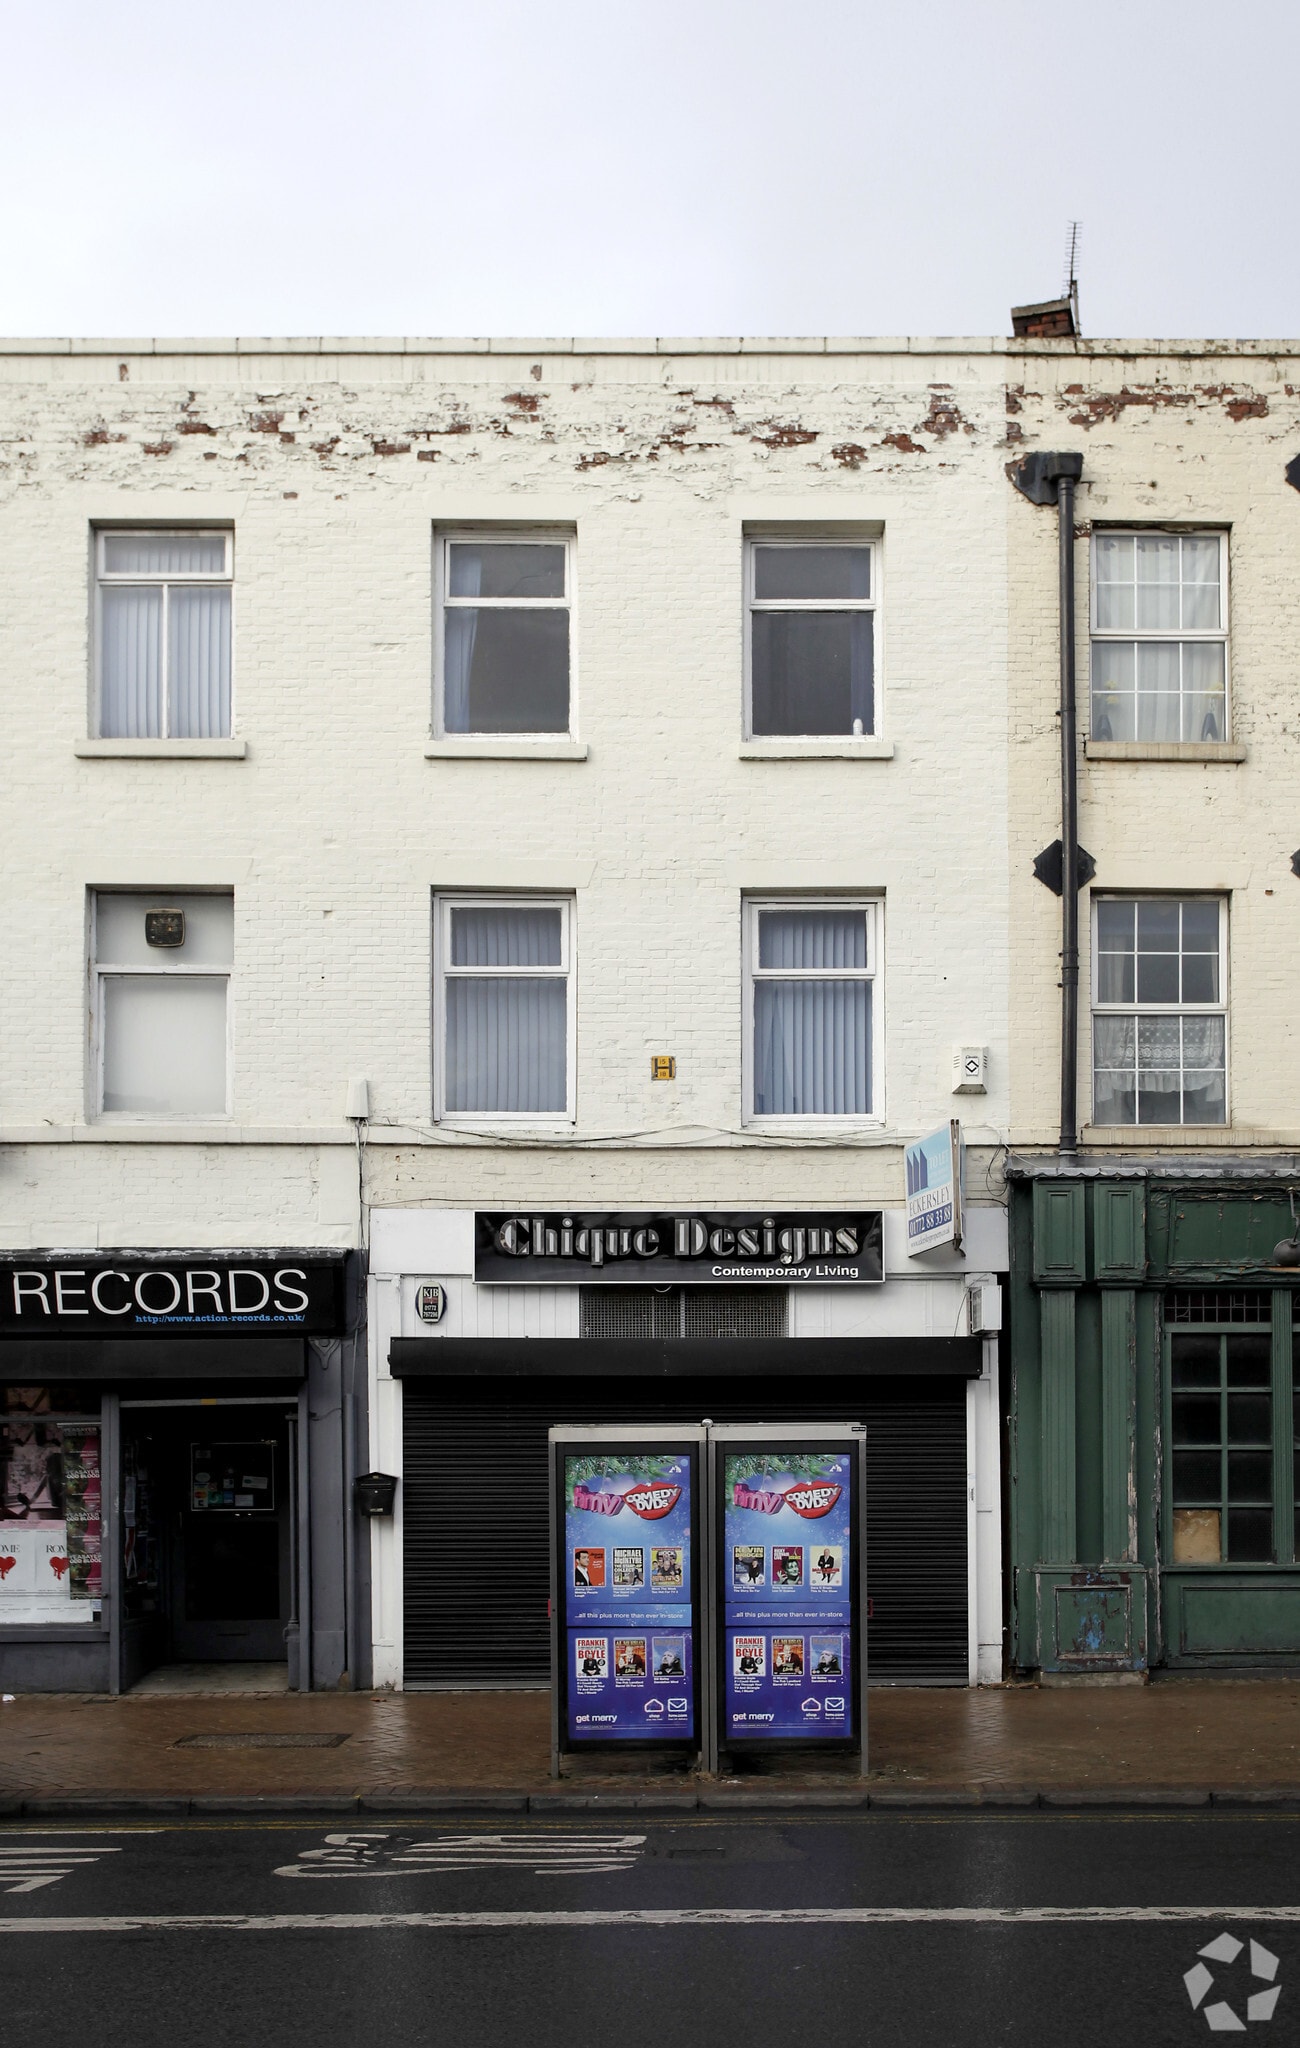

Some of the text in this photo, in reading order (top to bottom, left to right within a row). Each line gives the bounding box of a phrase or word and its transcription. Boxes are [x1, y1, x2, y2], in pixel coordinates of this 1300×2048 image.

[909, 1186, 951, 1217] ECKERSLEY
[909, 1204, 951, 1236] 01772 88 33 88
[499, 1217, 858, 1266] Chique Designs
[711, 1265, 859, 1279] Contemporary Living
[13, 1268, 309, 1315] RECORDS
[423, 1288, 438, 1299] KJB
[135, 1314, 306, 1324] http://www.action-records.co.uk/
[573, 1485, 626, 1517] hmv
[625, 1488, 678, 1503] COMEDY
[733, 1483, 786, 1515] hmv
[786, 1487, 839, 1502] COMEDY
[635, 1498, 669, 1511] DVDs
[796, 1497, 829, 1510] DVDs
[577, 1650, 606, 1659] BOYLE
[735, 1648, 763, 1657] BOYLE
[576, 1714, 617, 1724] get merry
[732, 1712, 774, 1722] get merry
